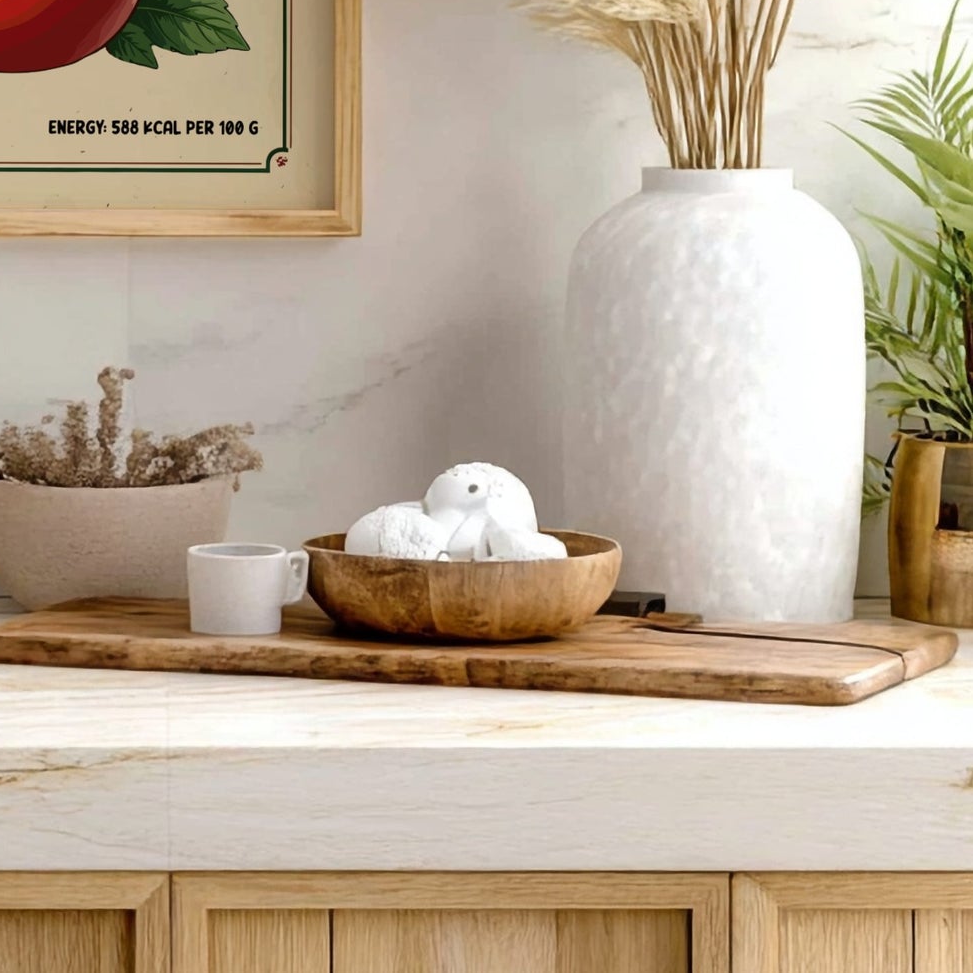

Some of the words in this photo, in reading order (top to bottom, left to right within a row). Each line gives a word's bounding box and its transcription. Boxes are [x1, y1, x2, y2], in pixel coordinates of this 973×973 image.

[48, 119, 107, 135] ENERGY:
[111, 119, 139, 135] 588
[143, 120, 182, 136] KCAL
[185, 120, 215, 136] PER
[218, 120, 245, 136] 100
[248, 120, 259, 136] G
